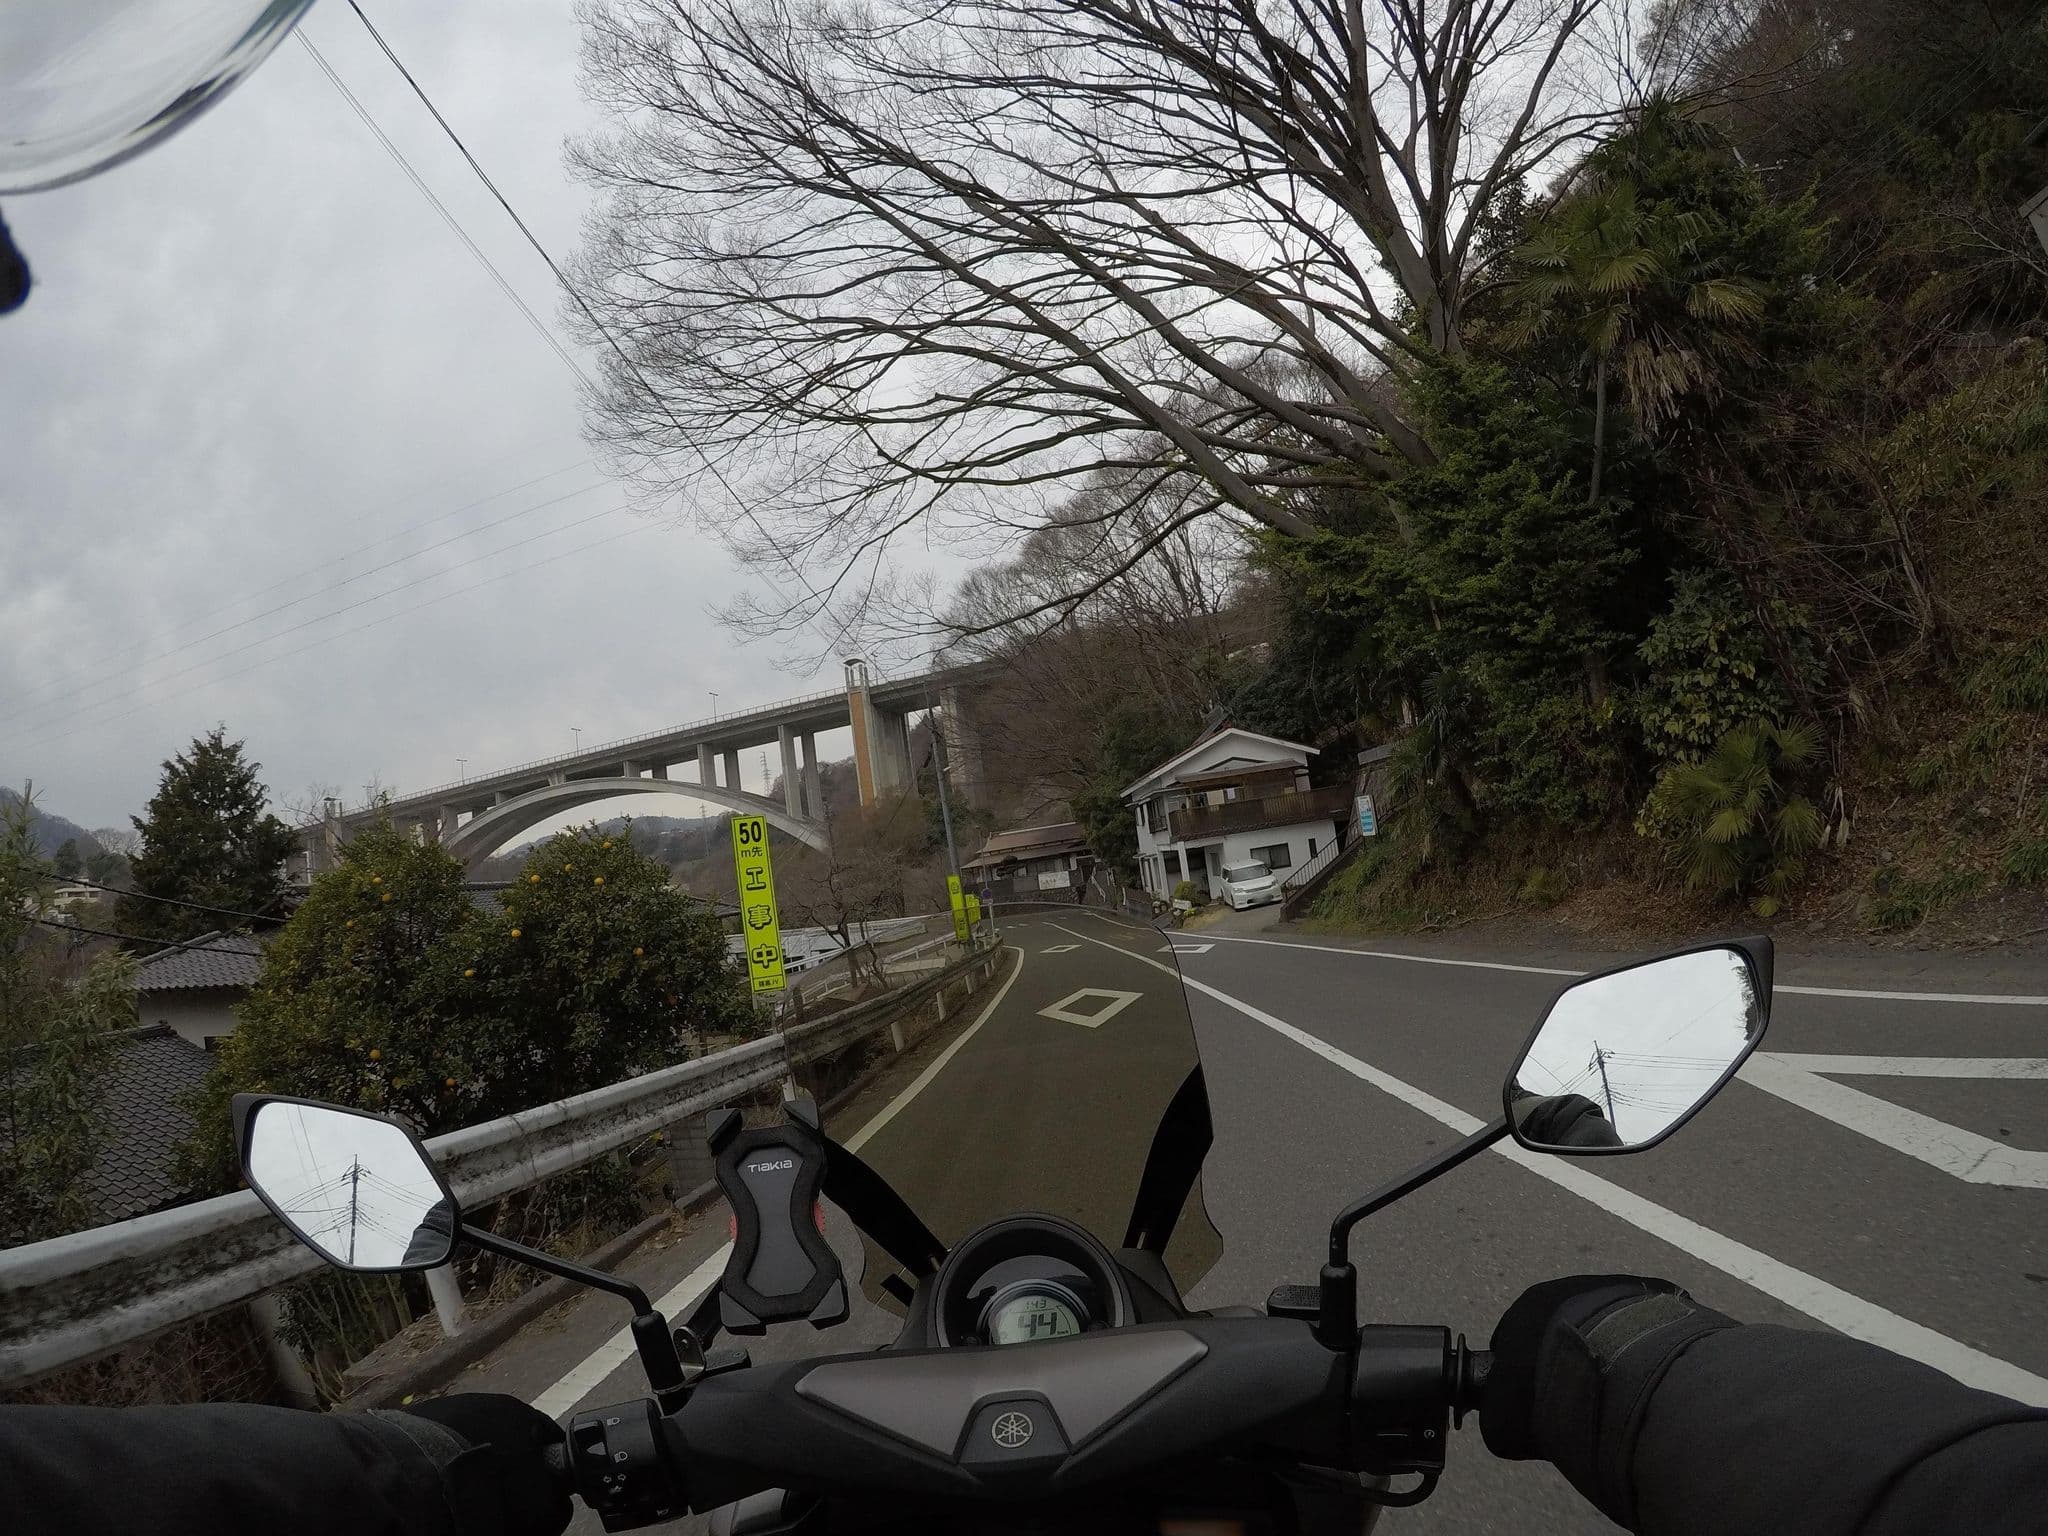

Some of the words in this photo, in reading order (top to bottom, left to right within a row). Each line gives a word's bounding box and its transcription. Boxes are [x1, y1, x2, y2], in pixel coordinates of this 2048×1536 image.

[739, 821, 762, 845] 50
[741, 846, 763, 858] m先
[746, 866, 779, 969] 工事中
[1017, 1312, 1058, 1338] 44
